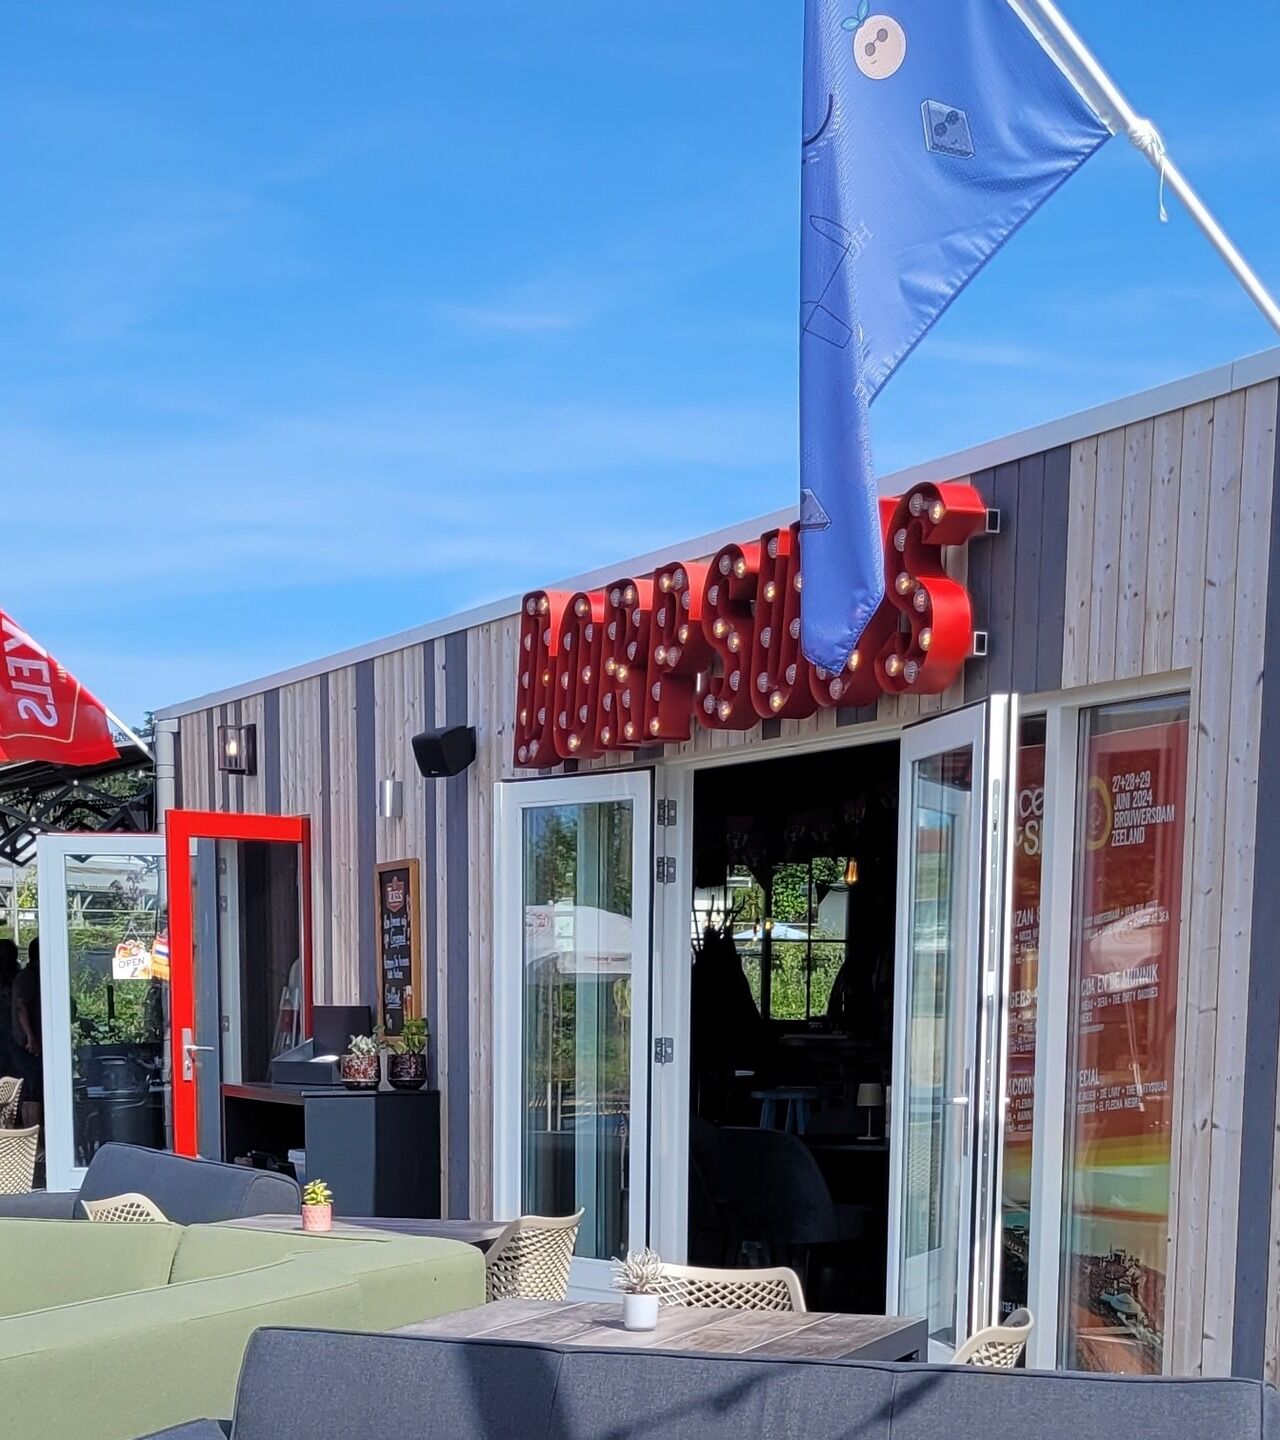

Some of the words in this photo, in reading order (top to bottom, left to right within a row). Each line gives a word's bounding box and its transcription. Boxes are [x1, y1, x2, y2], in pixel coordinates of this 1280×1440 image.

[1112, 771, 1151, 793] 27+28+29
[1114, 792, 1130, 810] JUNI
[1132, 789, 1153, 808] 2024
[1114, 804, 1175, 828] BROUWERSDAM
[1111, 827, 1145, 847] ZEELAND
[118, 957, 145, 969] OPEN
